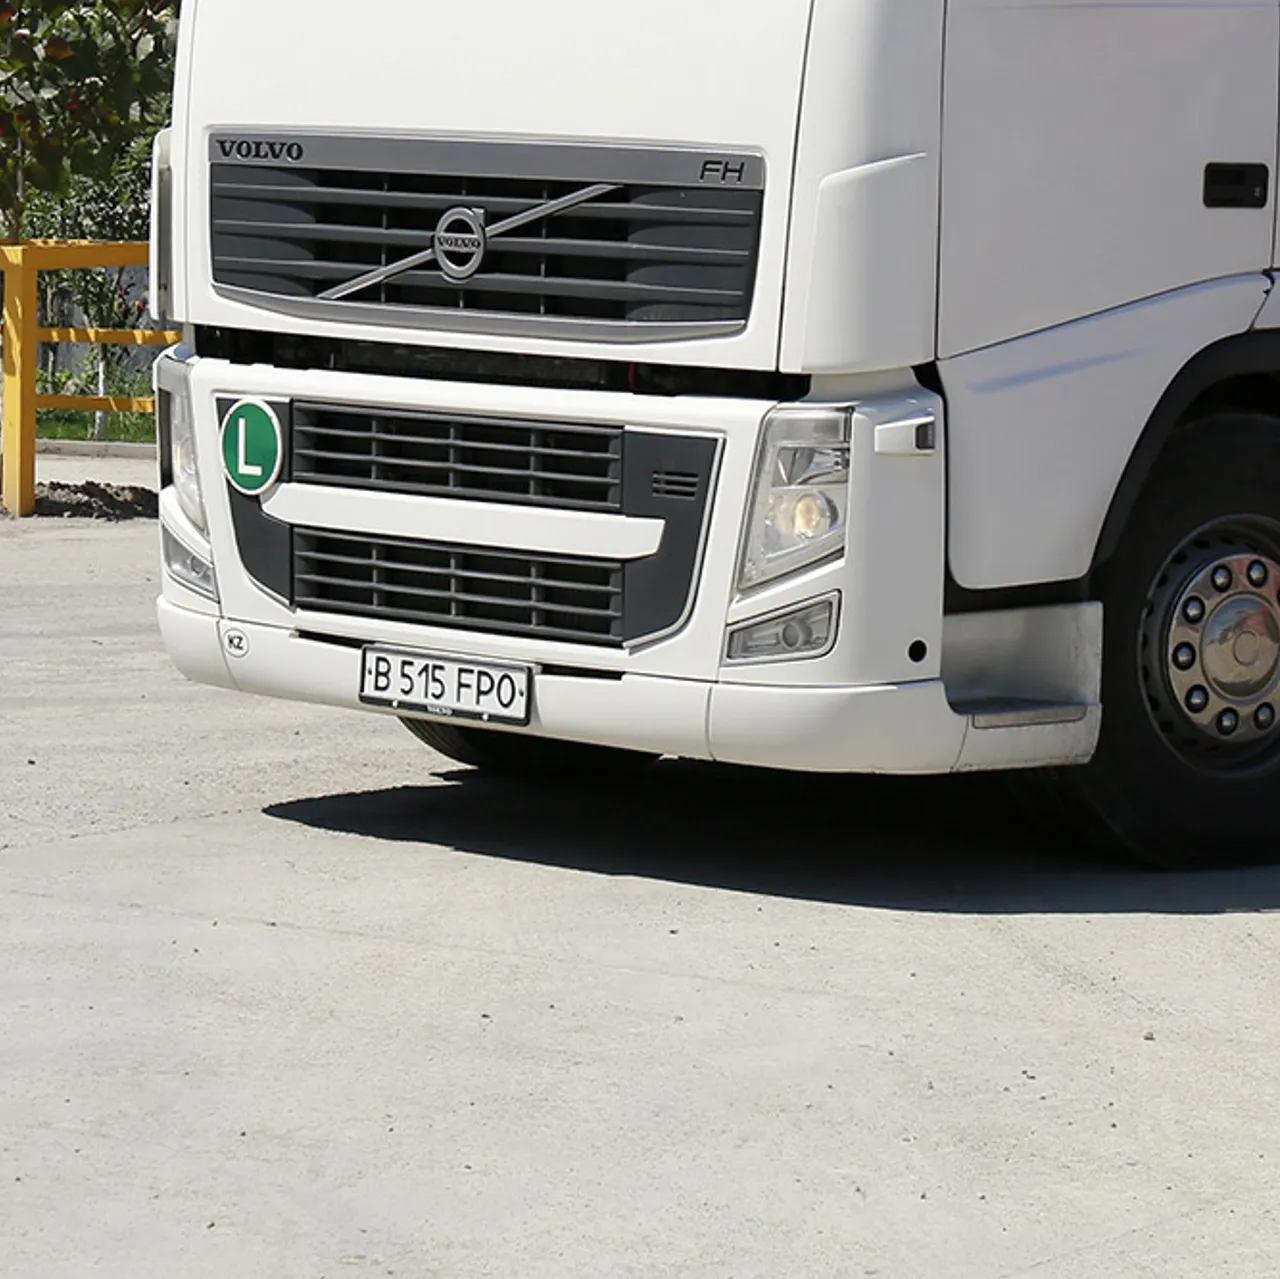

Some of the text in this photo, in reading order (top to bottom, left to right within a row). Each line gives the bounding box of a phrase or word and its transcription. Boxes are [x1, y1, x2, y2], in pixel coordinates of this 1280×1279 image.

[215, 139, 304, 160] VOLVO
[699, 160, 745, 182] FH
[436, 236, 481, 249] VOLVO
[238, 417, 263, 476] L
[227, 634, 244, 651] KZ
[374, 656, 516, 709] B 515 FPO
